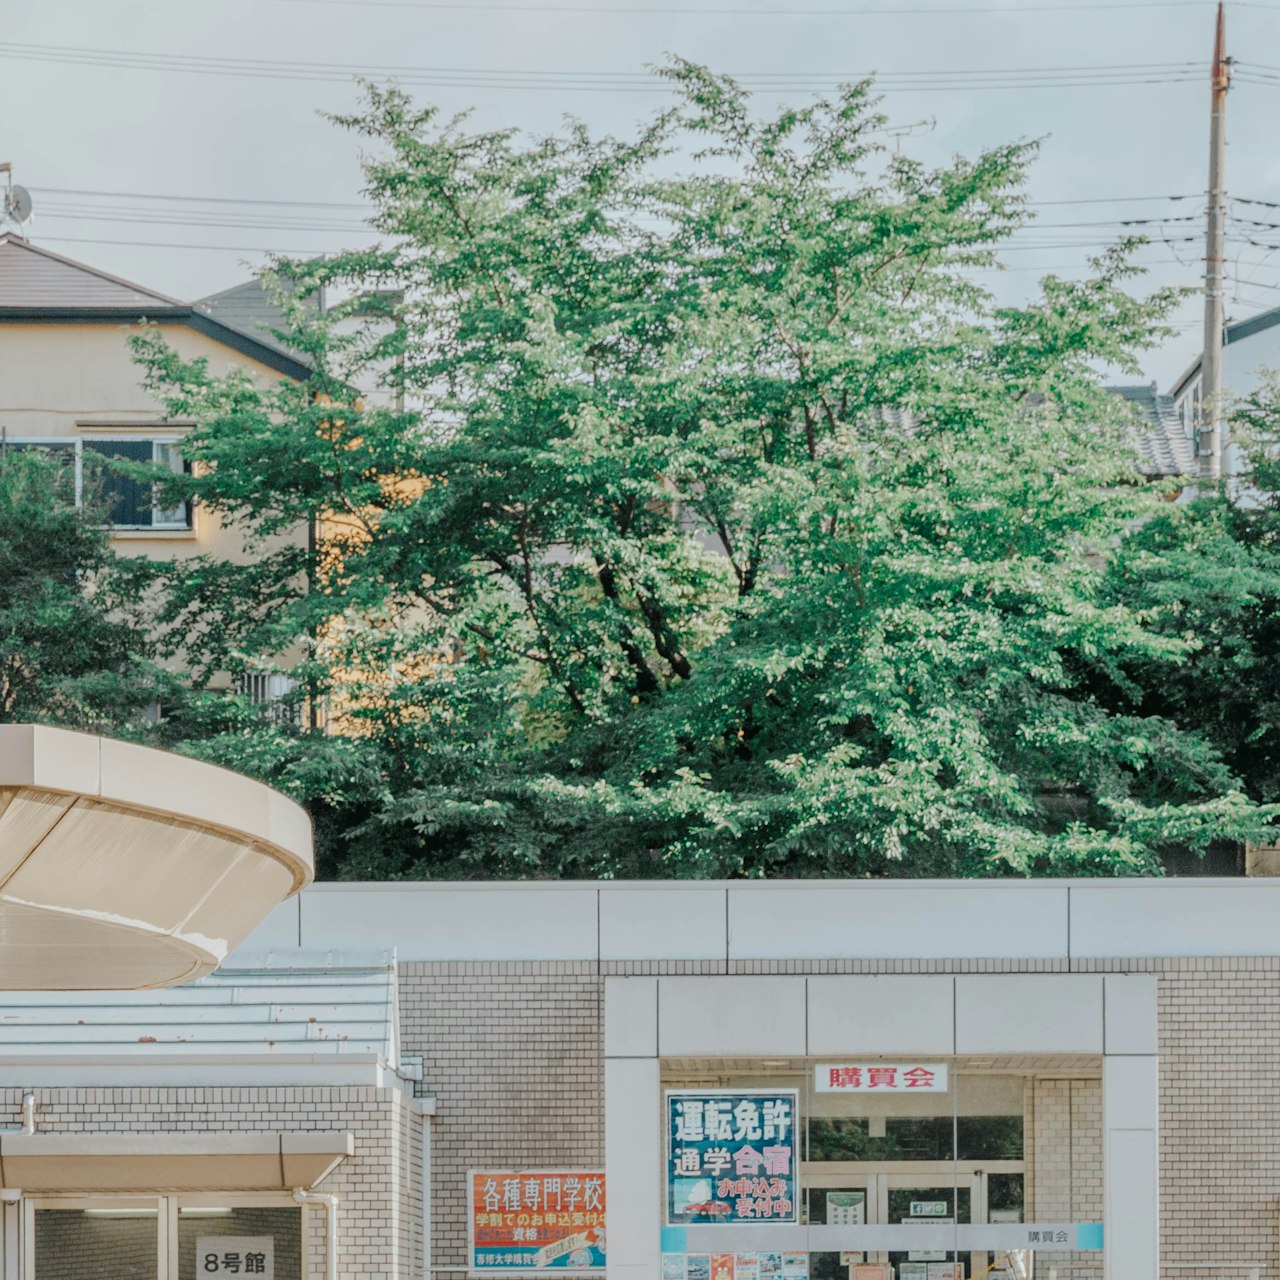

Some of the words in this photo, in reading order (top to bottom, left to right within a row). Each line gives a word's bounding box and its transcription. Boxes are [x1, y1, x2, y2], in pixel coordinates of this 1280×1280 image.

[828, 1066, 936, 1089] 購買会
[675, 1099, 791, 1141] 運転免許
[673, 1144, 791, 1176] 通学合宿
[483, 1178, 602, 1211] 各種専門学校
[717, 1177, 787, 1198] お申込み
[735, 1198, 792, 1217] 受付中
[1027, 1229, 1069, 1244] 購買会
[205, 1253, 266, 1273] 8号館
